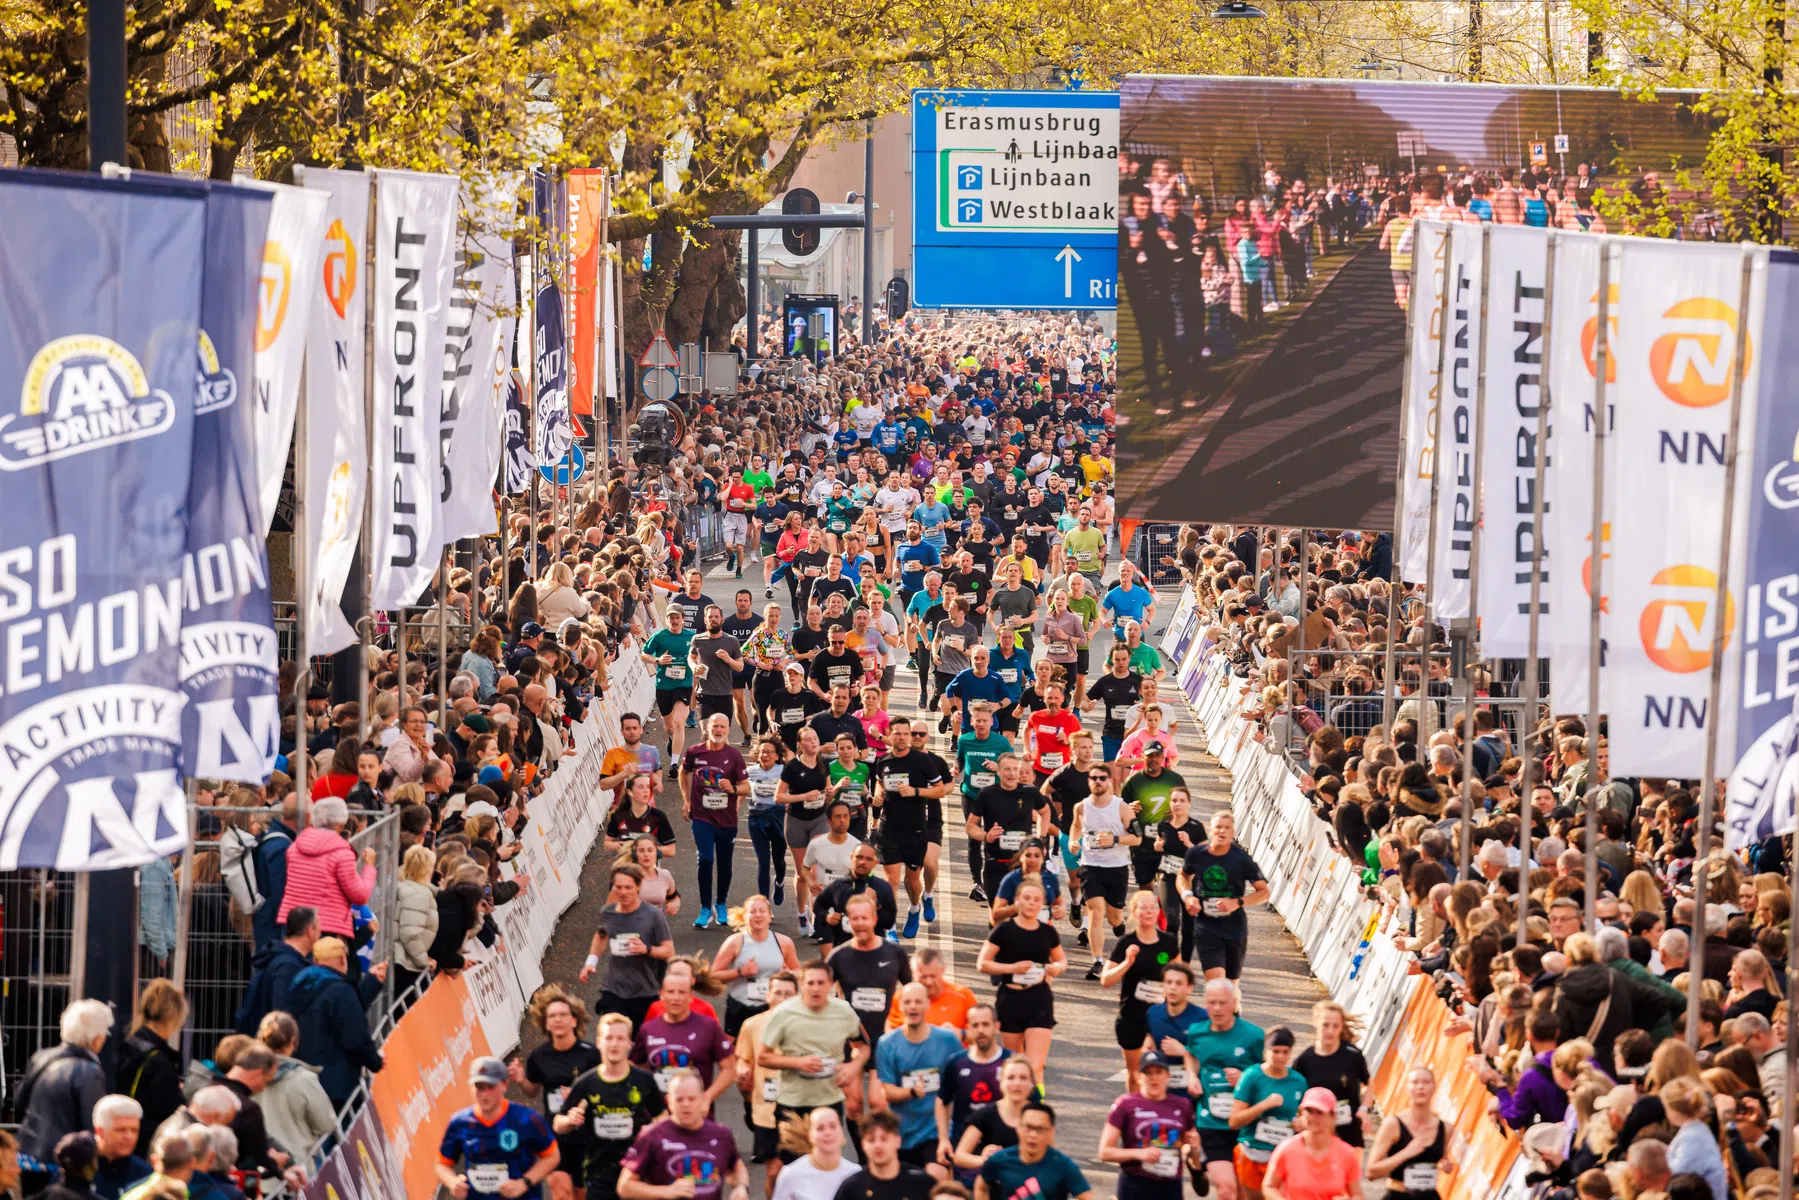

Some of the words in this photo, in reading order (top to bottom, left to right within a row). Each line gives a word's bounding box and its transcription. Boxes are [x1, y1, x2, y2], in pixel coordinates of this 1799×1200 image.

[944, 112, 1100, 136] Erasmusbrug
[991, 168, 1091, 190] Lijnbaan
[990, 200, 1115, 220] Westblaak
[391, 216, 427, 568] UPFRONT
[44, 406, 142, 450] DRINK
[1659, 430, 1726, 466] NN
[1643, 695, 1707, 728] NN
[3, 698, 165, 771] ACTIVITY
[62, 737, 116, 769] TRADE
[1149, 796, 1166, 815] 7
